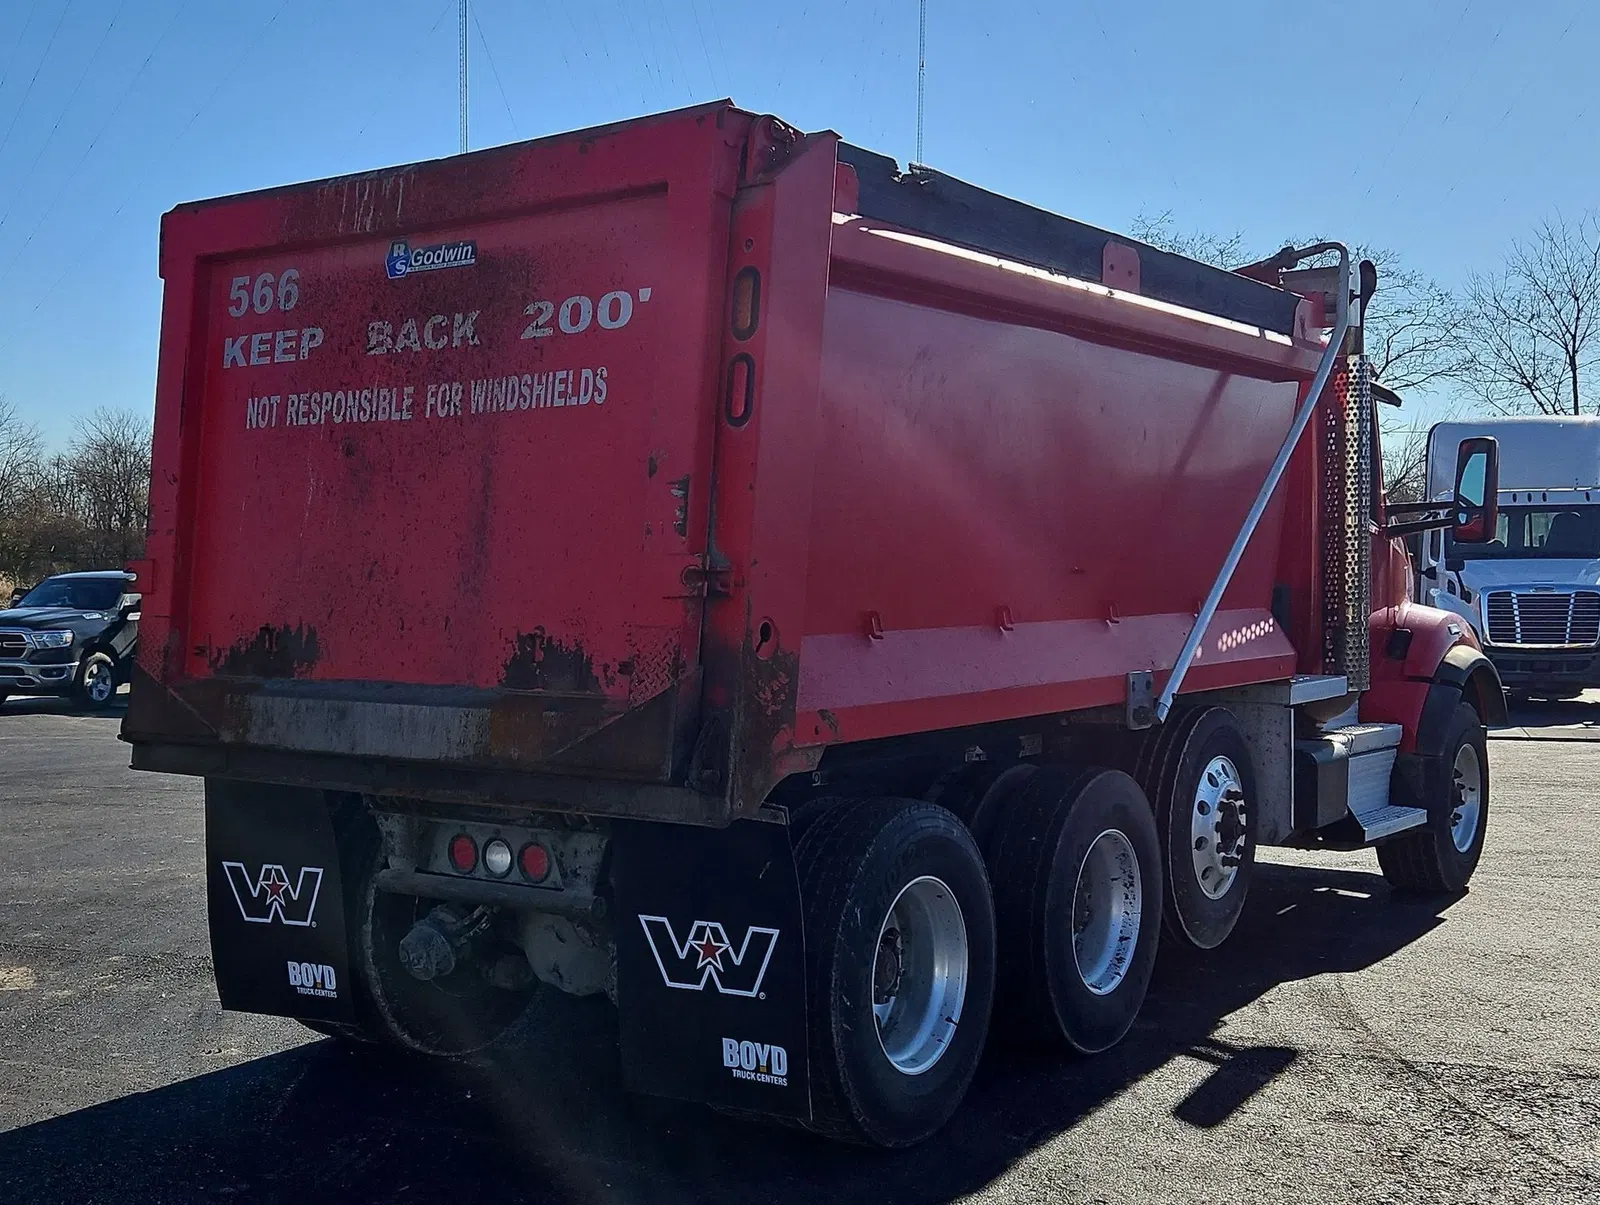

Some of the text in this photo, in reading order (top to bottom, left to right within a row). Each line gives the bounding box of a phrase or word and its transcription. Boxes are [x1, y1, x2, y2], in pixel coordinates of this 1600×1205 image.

[228, 268, 300, 317] 566
[223, 327, 324, 369] KEEP
[366, 310, 481, 355] BACK
[246, 366, 608, 429] NOT RESPONSIBLE FOR WINDSHIELDS
[287, 961, 336, 989] BOYD
[722, 1037, 788, 1075] BOYD
[732, 1068, 788, 1087] TRUCK CENTERS
